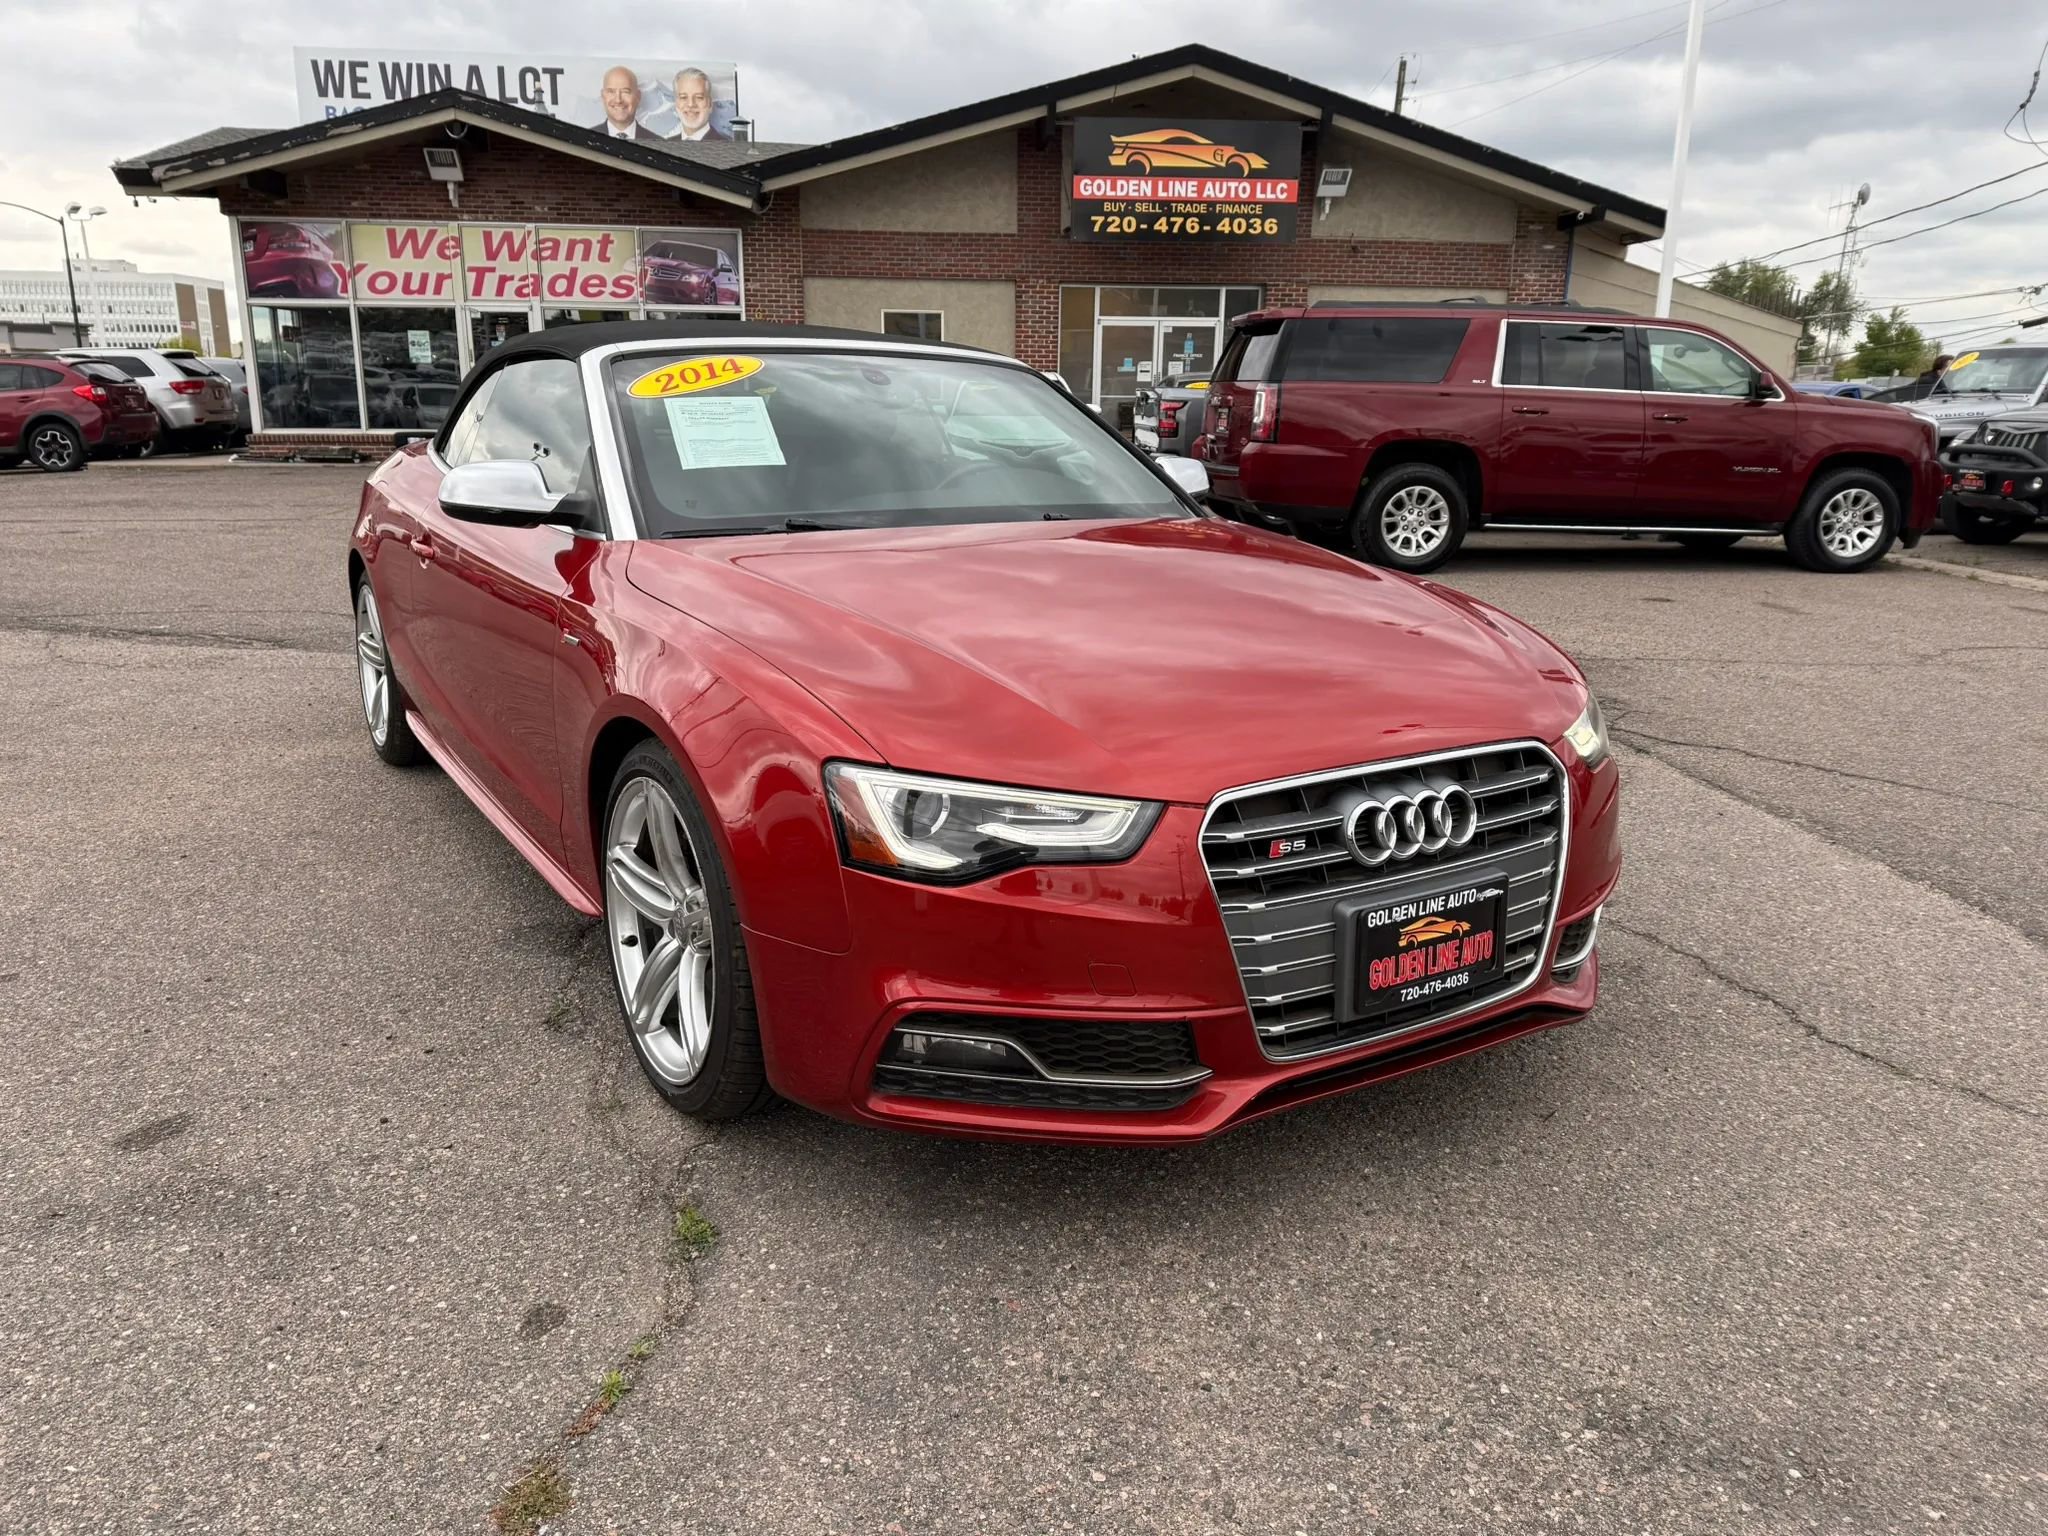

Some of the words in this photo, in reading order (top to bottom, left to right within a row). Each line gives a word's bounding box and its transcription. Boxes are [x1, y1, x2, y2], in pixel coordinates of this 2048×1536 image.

[310, 59, 371, 99] WE
[378, 61, 451, 100] WIN
[465, 64, 488, 98] A
[497, 65, 565, 106] LOT
[1079, 178, 1152, 197] GOLDEN
[1157, 180, 1198, 198] LINE
[1202, 181, 1251, 199] AUTO
[1256, 182, 1288, 200] LLC
[1103, 202, 1127, 212] BUY
[1135, 203, 1162, 213] SELL
[1171, 203, 1207, 214] TRADE
[1215, 204, 1263, 215] FINANCE
[386, 227, 461, 261] We
[482, 230, 615, 263] Want
[331, 262, 453, 296] Your
[466, 266, 649, 299] Trades!
[655, 358, 744, 393] 2014
[1279, 839, 1307, 853] S5
[1367, 902, 1416, 928] GOLDEN
[1418, 896, 1446, 915] LINE
[1447, 888, 1477, 909] AUTO
[1369, 948, 1426, 990] GOLDEN
[1427, 939, 1460, 975] LINE
[1461, 930, 1493, 966] AUTO
[1400, 972, 1469, 1002] 720-476-4036
